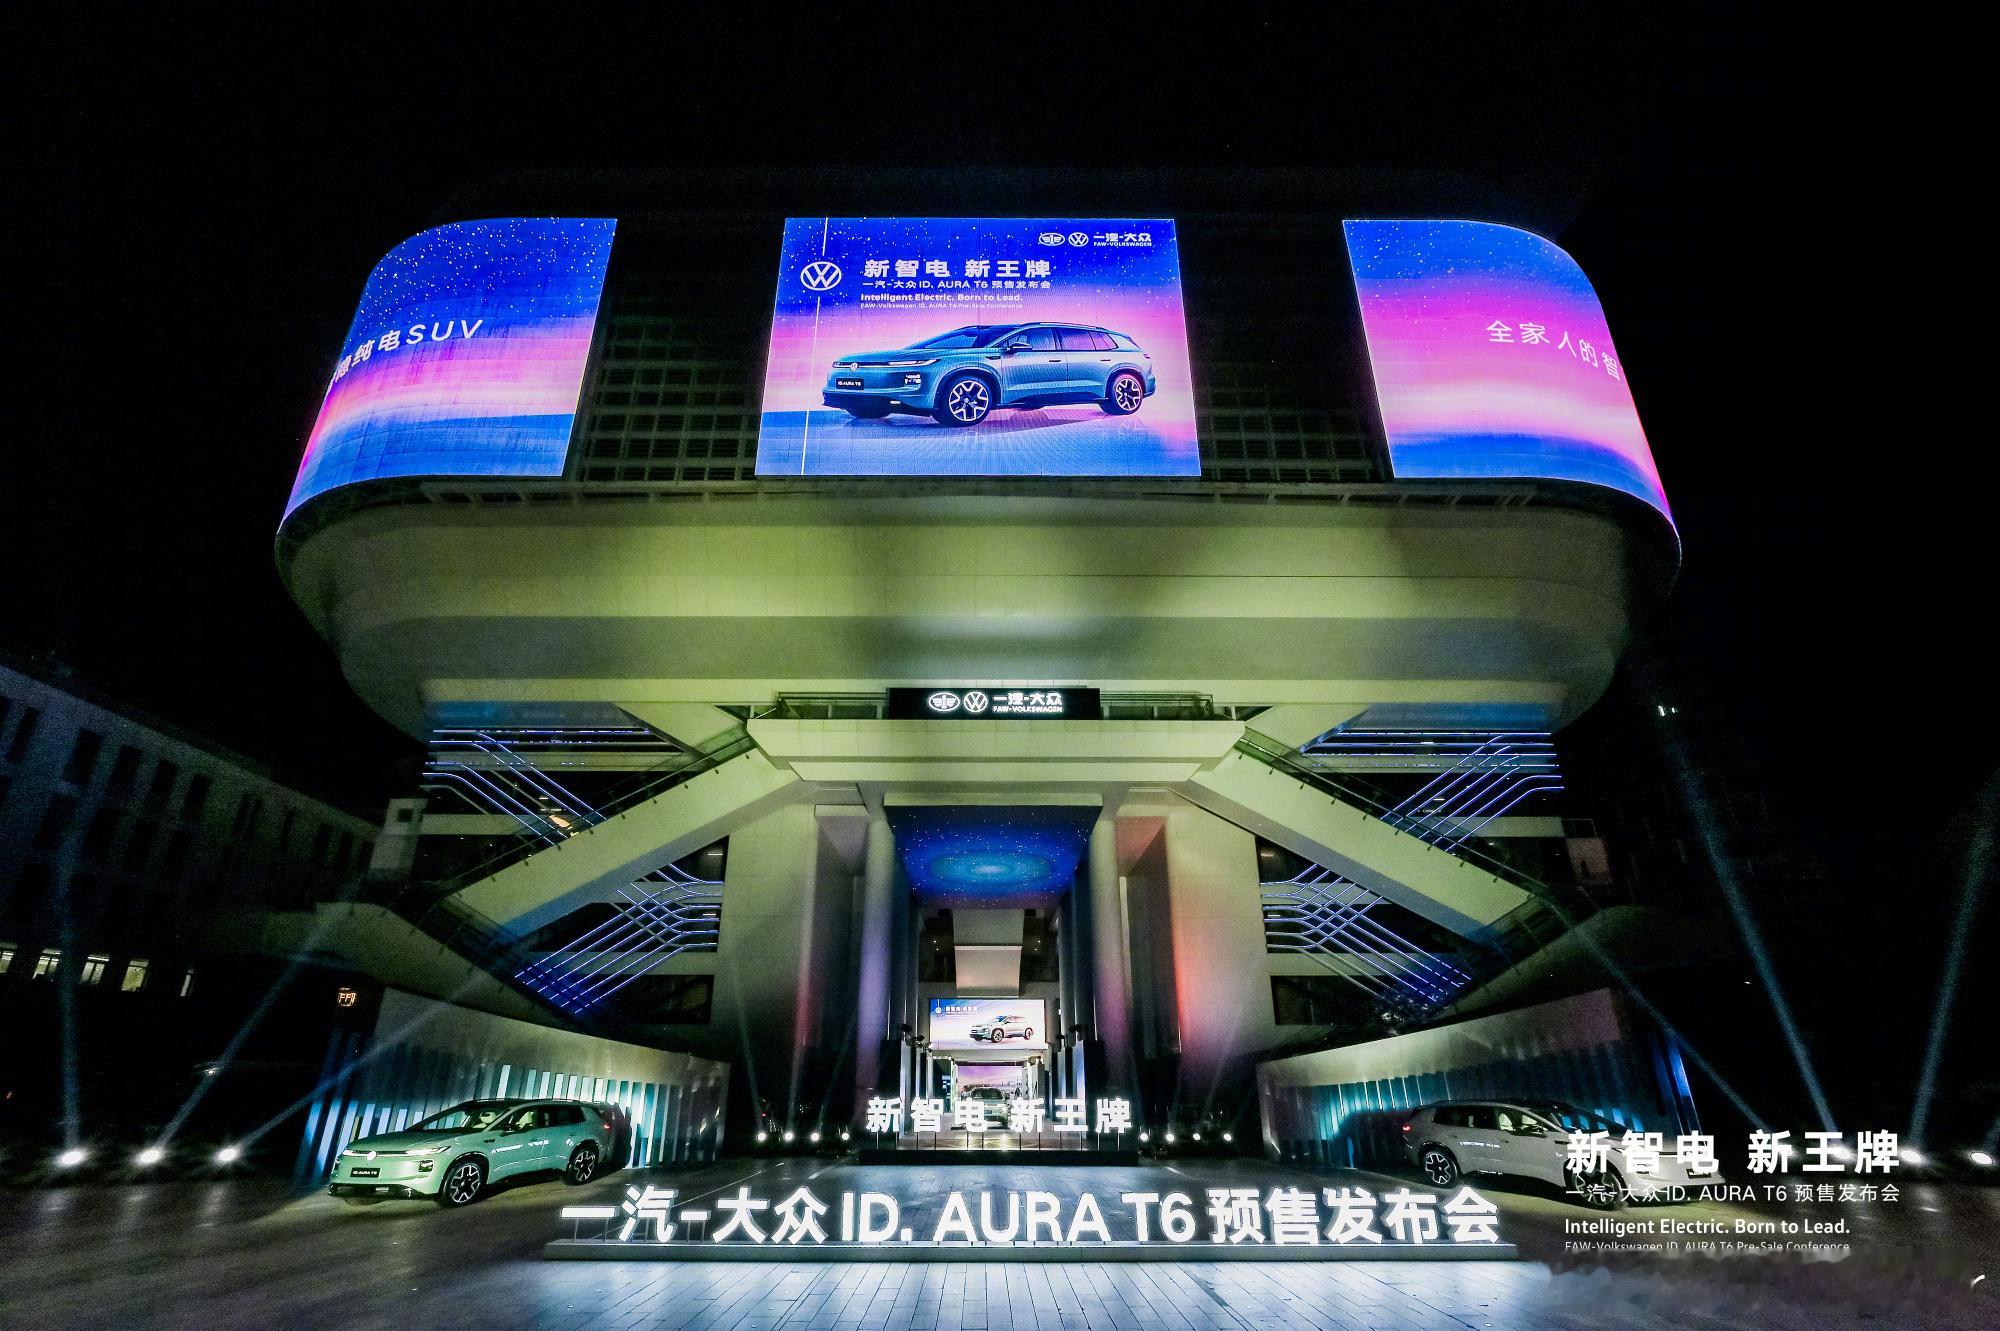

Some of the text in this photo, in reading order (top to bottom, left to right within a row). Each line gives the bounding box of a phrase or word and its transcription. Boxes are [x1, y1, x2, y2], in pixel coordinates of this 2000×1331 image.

[864, 259, 1051, 278] 新智电 新王牌
[937, 280, 970, 289] AURA
[973, 280, 989, 289] T6
[1486, 320, 1621, 382] 全家人的智
[865, 1096, 1133, 1133] 新智电 新王牌
[560, 1184, 831, 1245] 一汽-大众
[931, 1190, 1113, 1243] AURA
[1120, 1191, 1197, 1243] T6
[1206, 1186, 1501, 1245] 预售发布会
